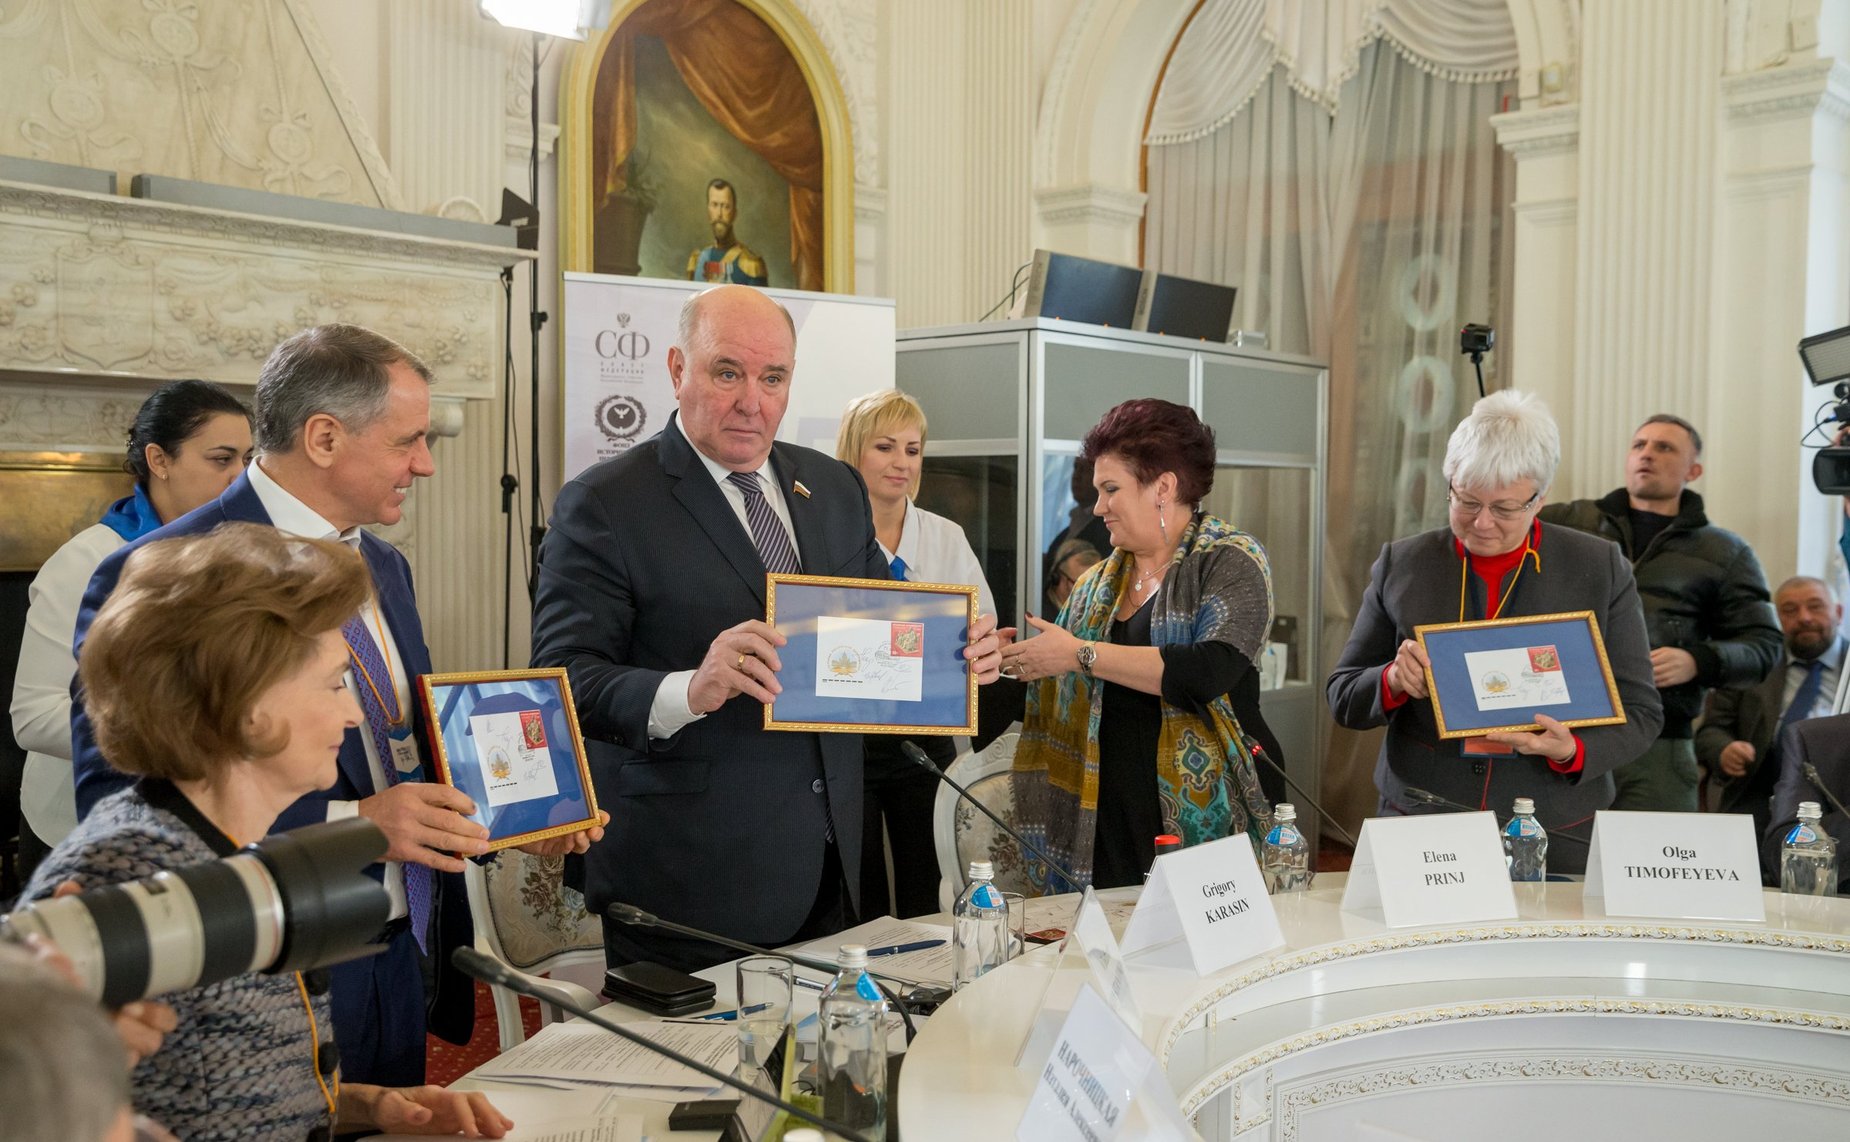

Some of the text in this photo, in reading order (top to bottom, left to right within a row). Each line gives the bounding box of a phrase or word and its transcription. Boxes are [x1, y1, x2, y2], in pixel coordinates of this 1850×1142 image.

[595, 330, 650, 360] СФ
[1423, 851, 1457, 863] Elena
[1662, 845, 1697, 861] Olga
[1424, 871, 1465, 886] PRINJ
[1624, 865, 1741, 881] TIMOFEYEVA
[1202, 880, 1236, 898] Grigory
[1205, 897, 1250, 924] KARASIN
